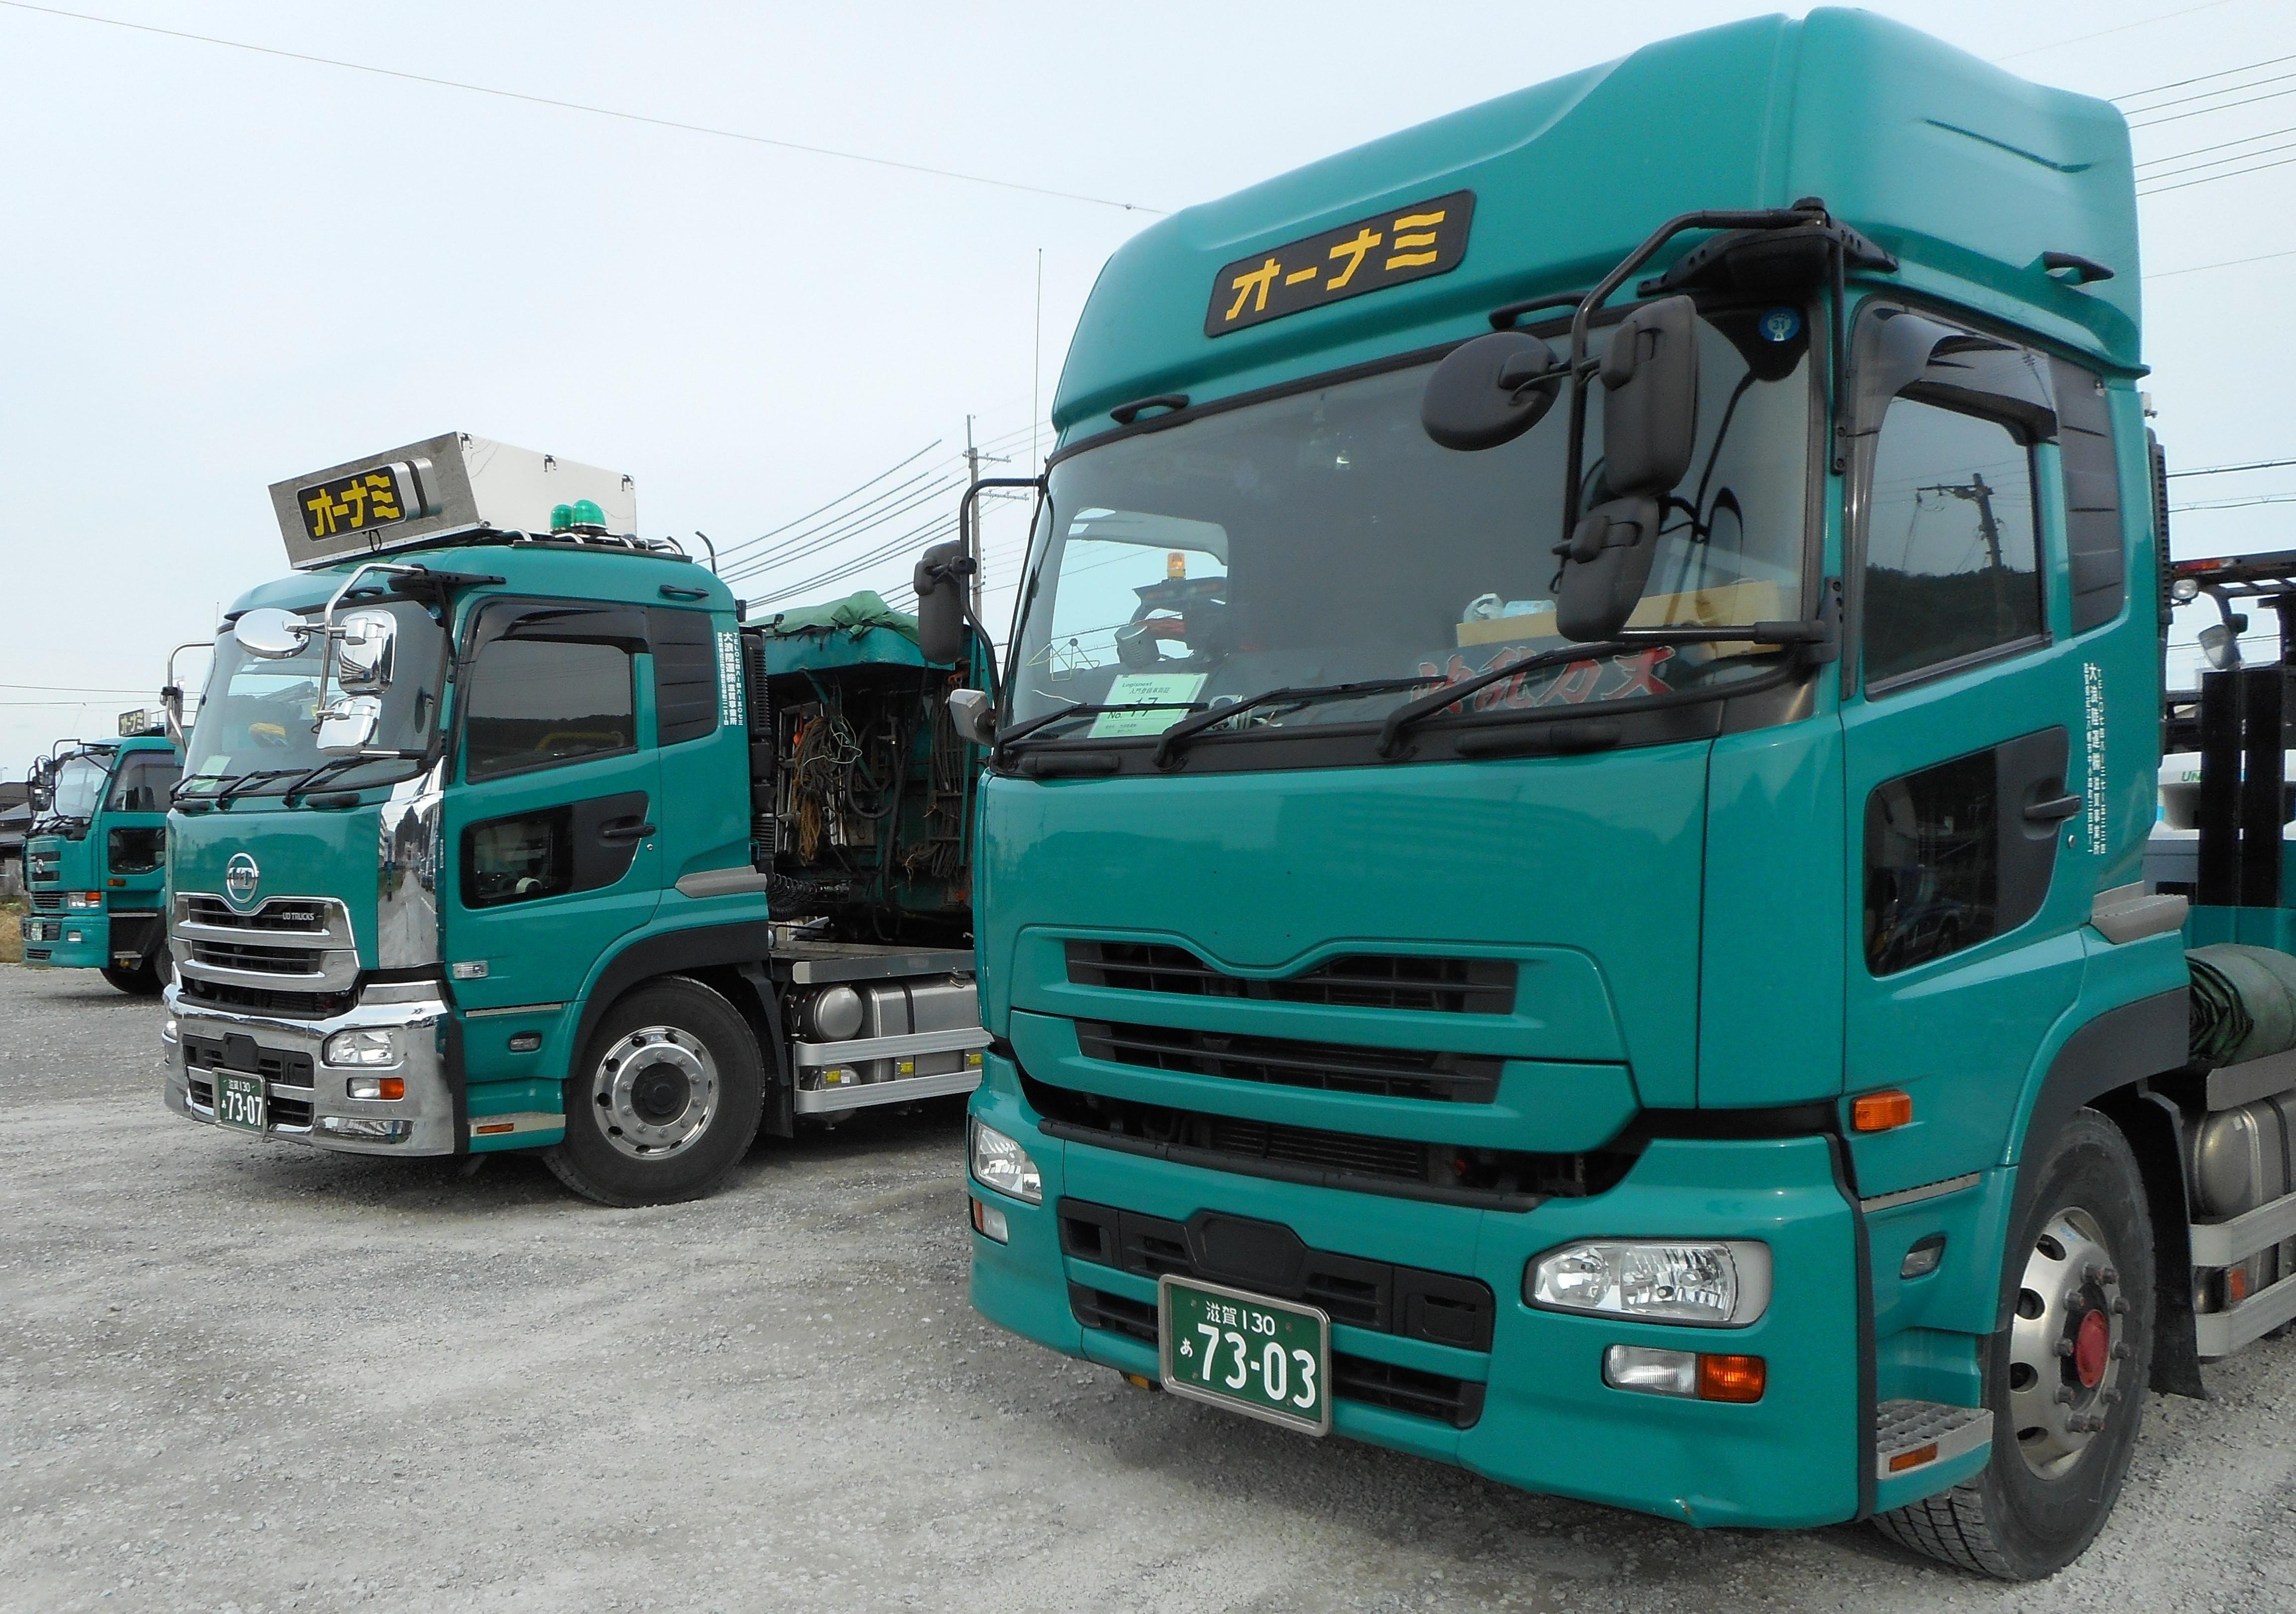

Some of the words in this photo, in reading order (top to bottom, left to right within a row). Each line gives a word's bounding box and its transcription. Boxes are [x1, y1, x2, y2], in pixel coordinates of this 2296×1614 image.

[1226, 211, 1445, 321] オーナミ
[307, 474, 400, 536] オーナミ
[291, 912, 314, 921] TRUCKS
[227, 1091, 262, 1126] 73-07
[1180, 1337, 1193, 1358] あ
[1198, 1323, 1316, 1408] 73-03
